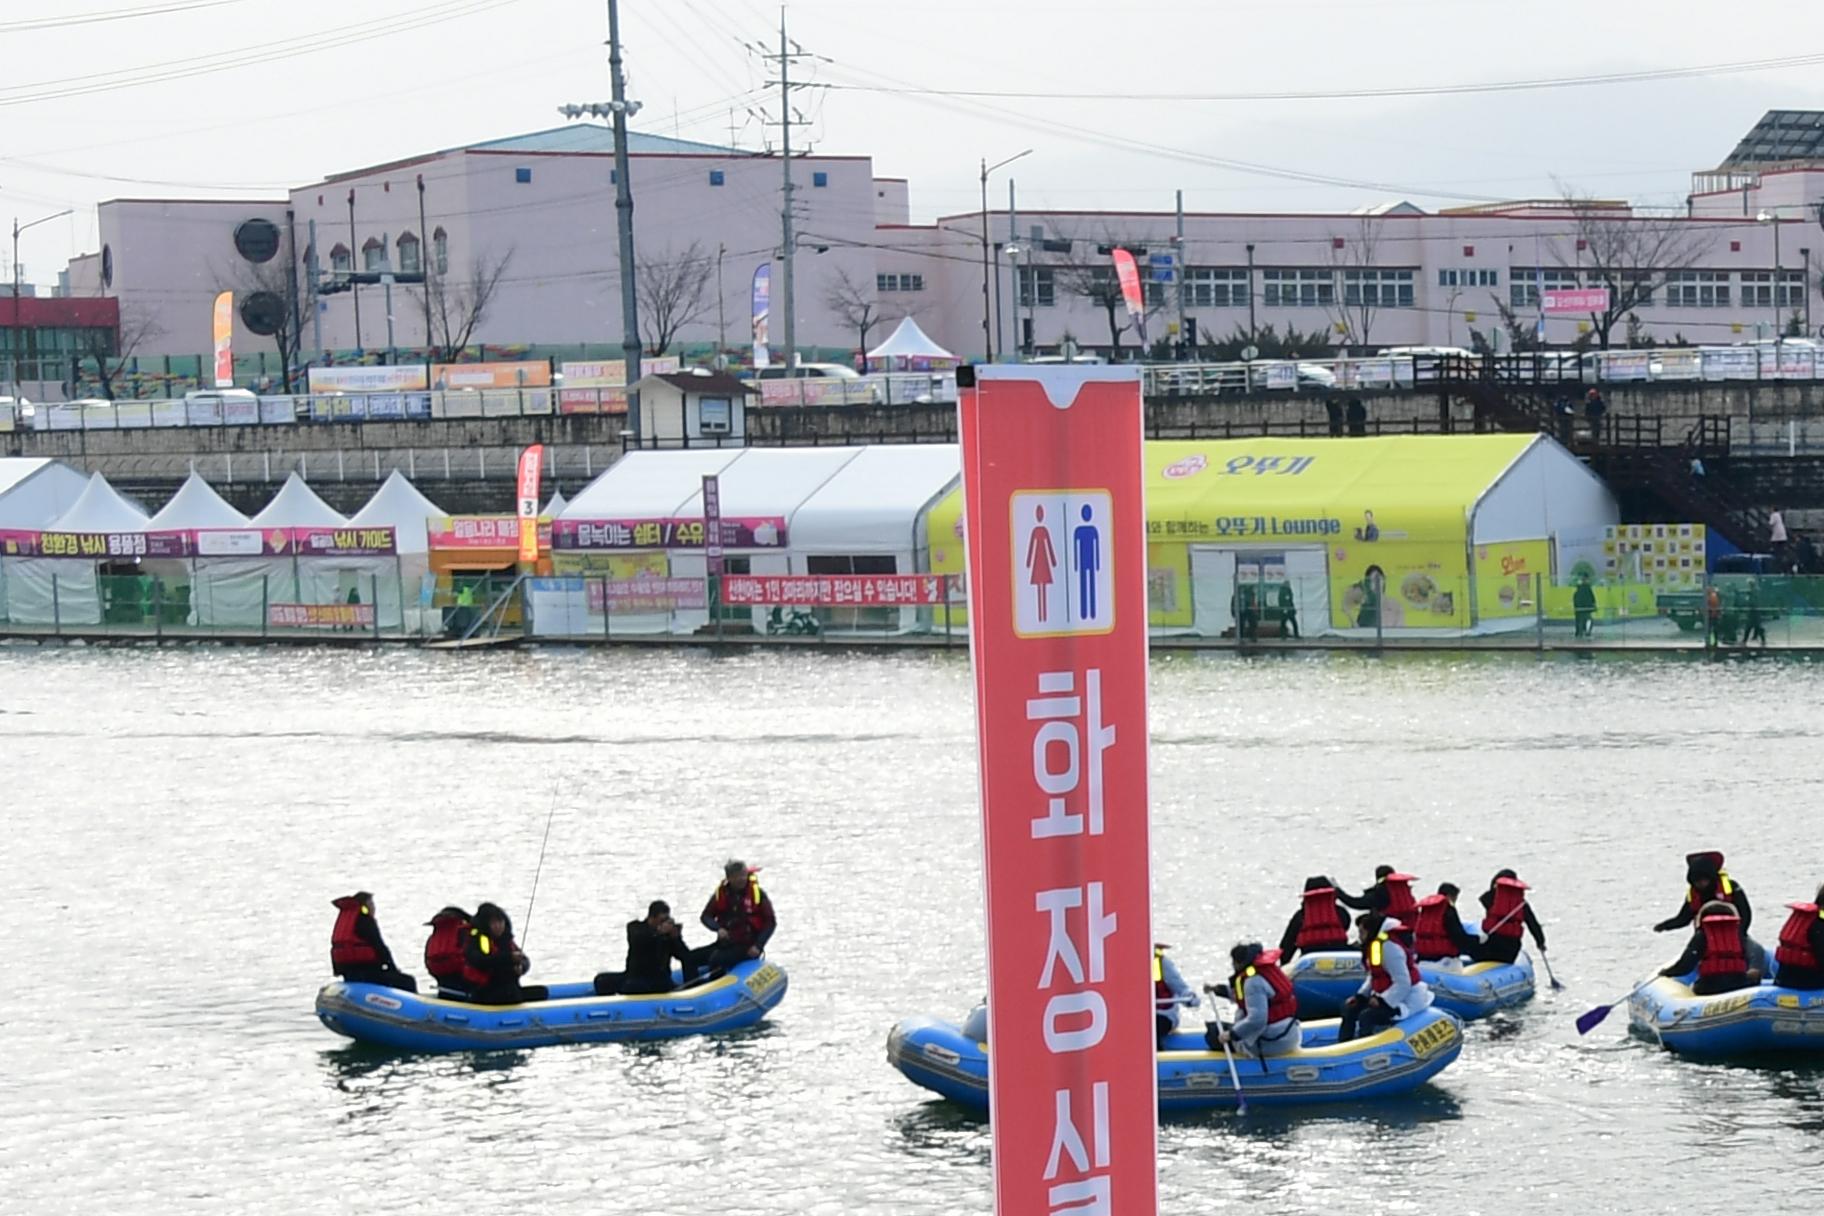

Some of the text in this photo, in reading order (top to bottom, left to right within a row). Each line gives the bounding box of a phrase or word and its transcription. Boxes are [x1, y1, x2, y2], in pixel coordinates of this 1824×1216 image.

[1219, 455, 1316, 476] 오뚜기
[524, 500, 534, 515] 3
[633, 523, 662, 545] 쉼터
[1215, 516, 1267, 536] 오뚜기
[1271, 517, 1341, 535] Lounge
